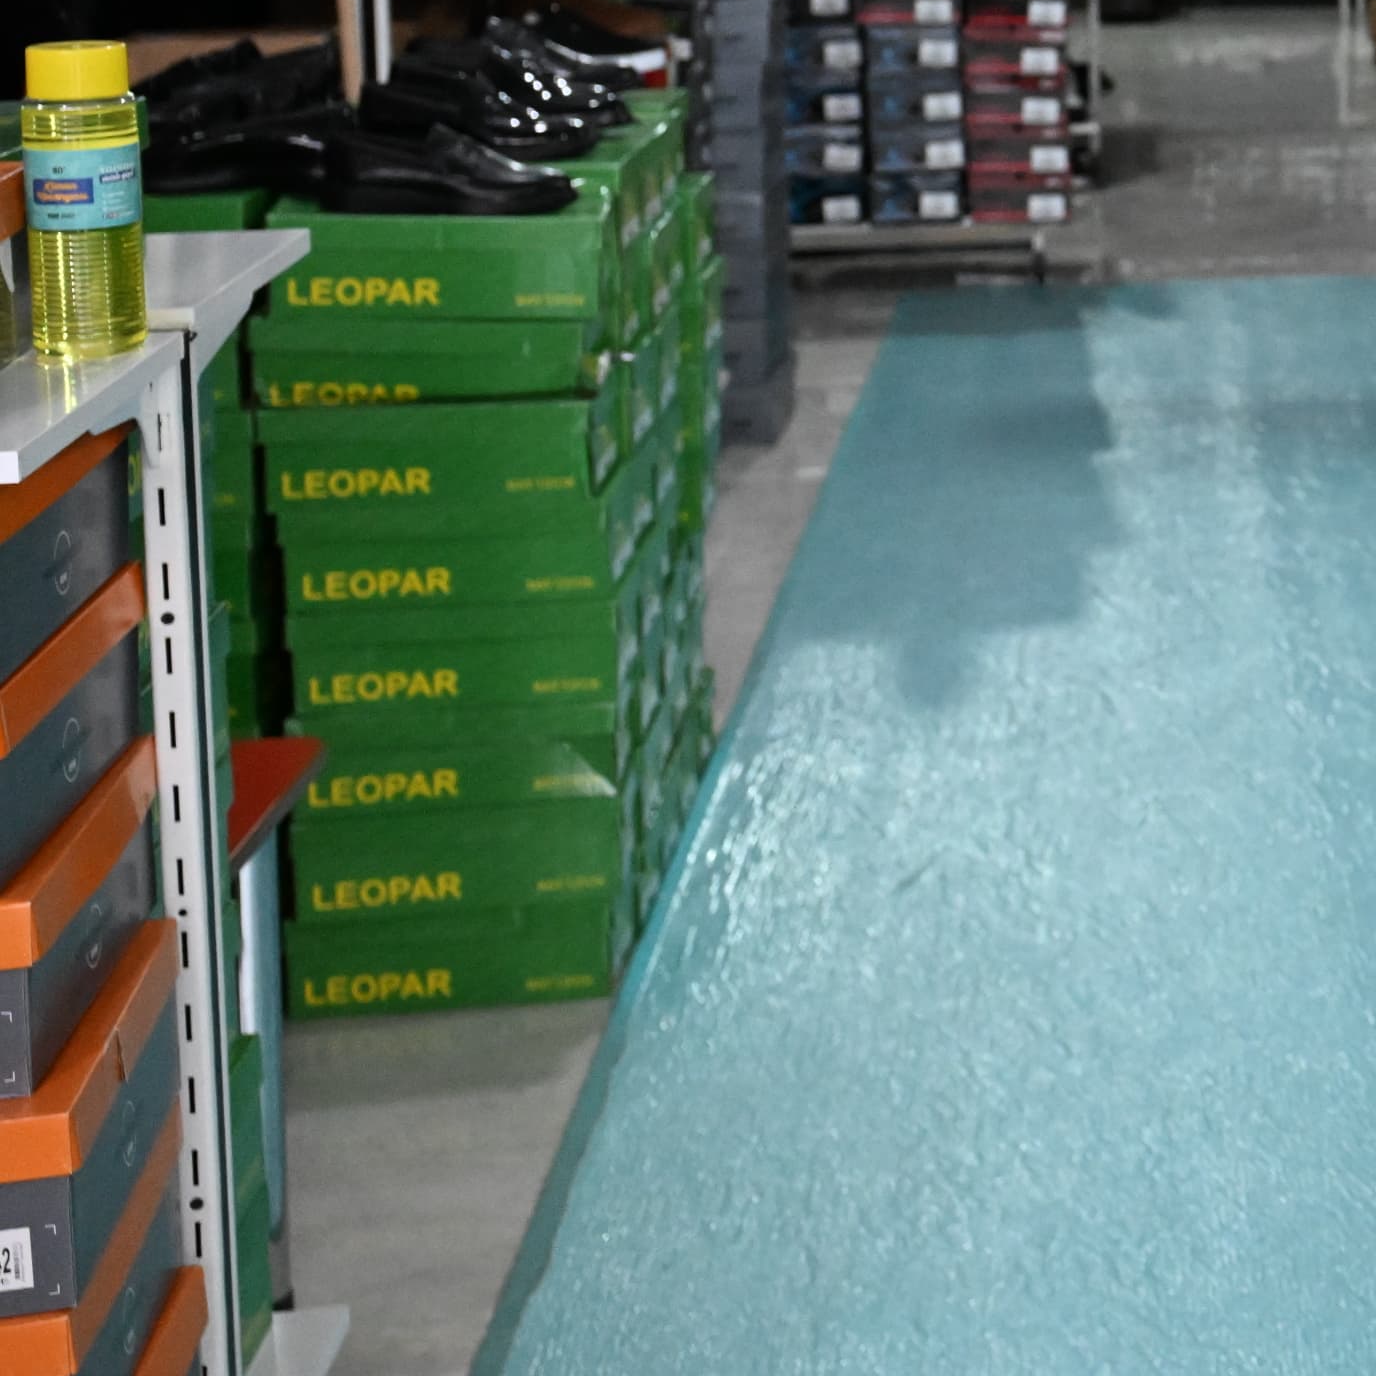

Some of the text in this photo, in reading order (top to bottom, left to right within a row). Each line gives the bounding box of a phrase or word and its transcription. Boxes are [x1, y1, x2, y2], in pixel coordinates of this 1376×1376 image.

[287, 277, 441, 307] LEOPAR
[280, 467, 432, 500] LEOPAR
[302, 567, 452, 601] LEOPAR
[309, 669, 459, 704] LEOPAR
[308, 768, 459, 808] LEOPAR
[312, 871, 463, 911] LEOPAR
[304, 968, 452, 1006] LEOPAR
